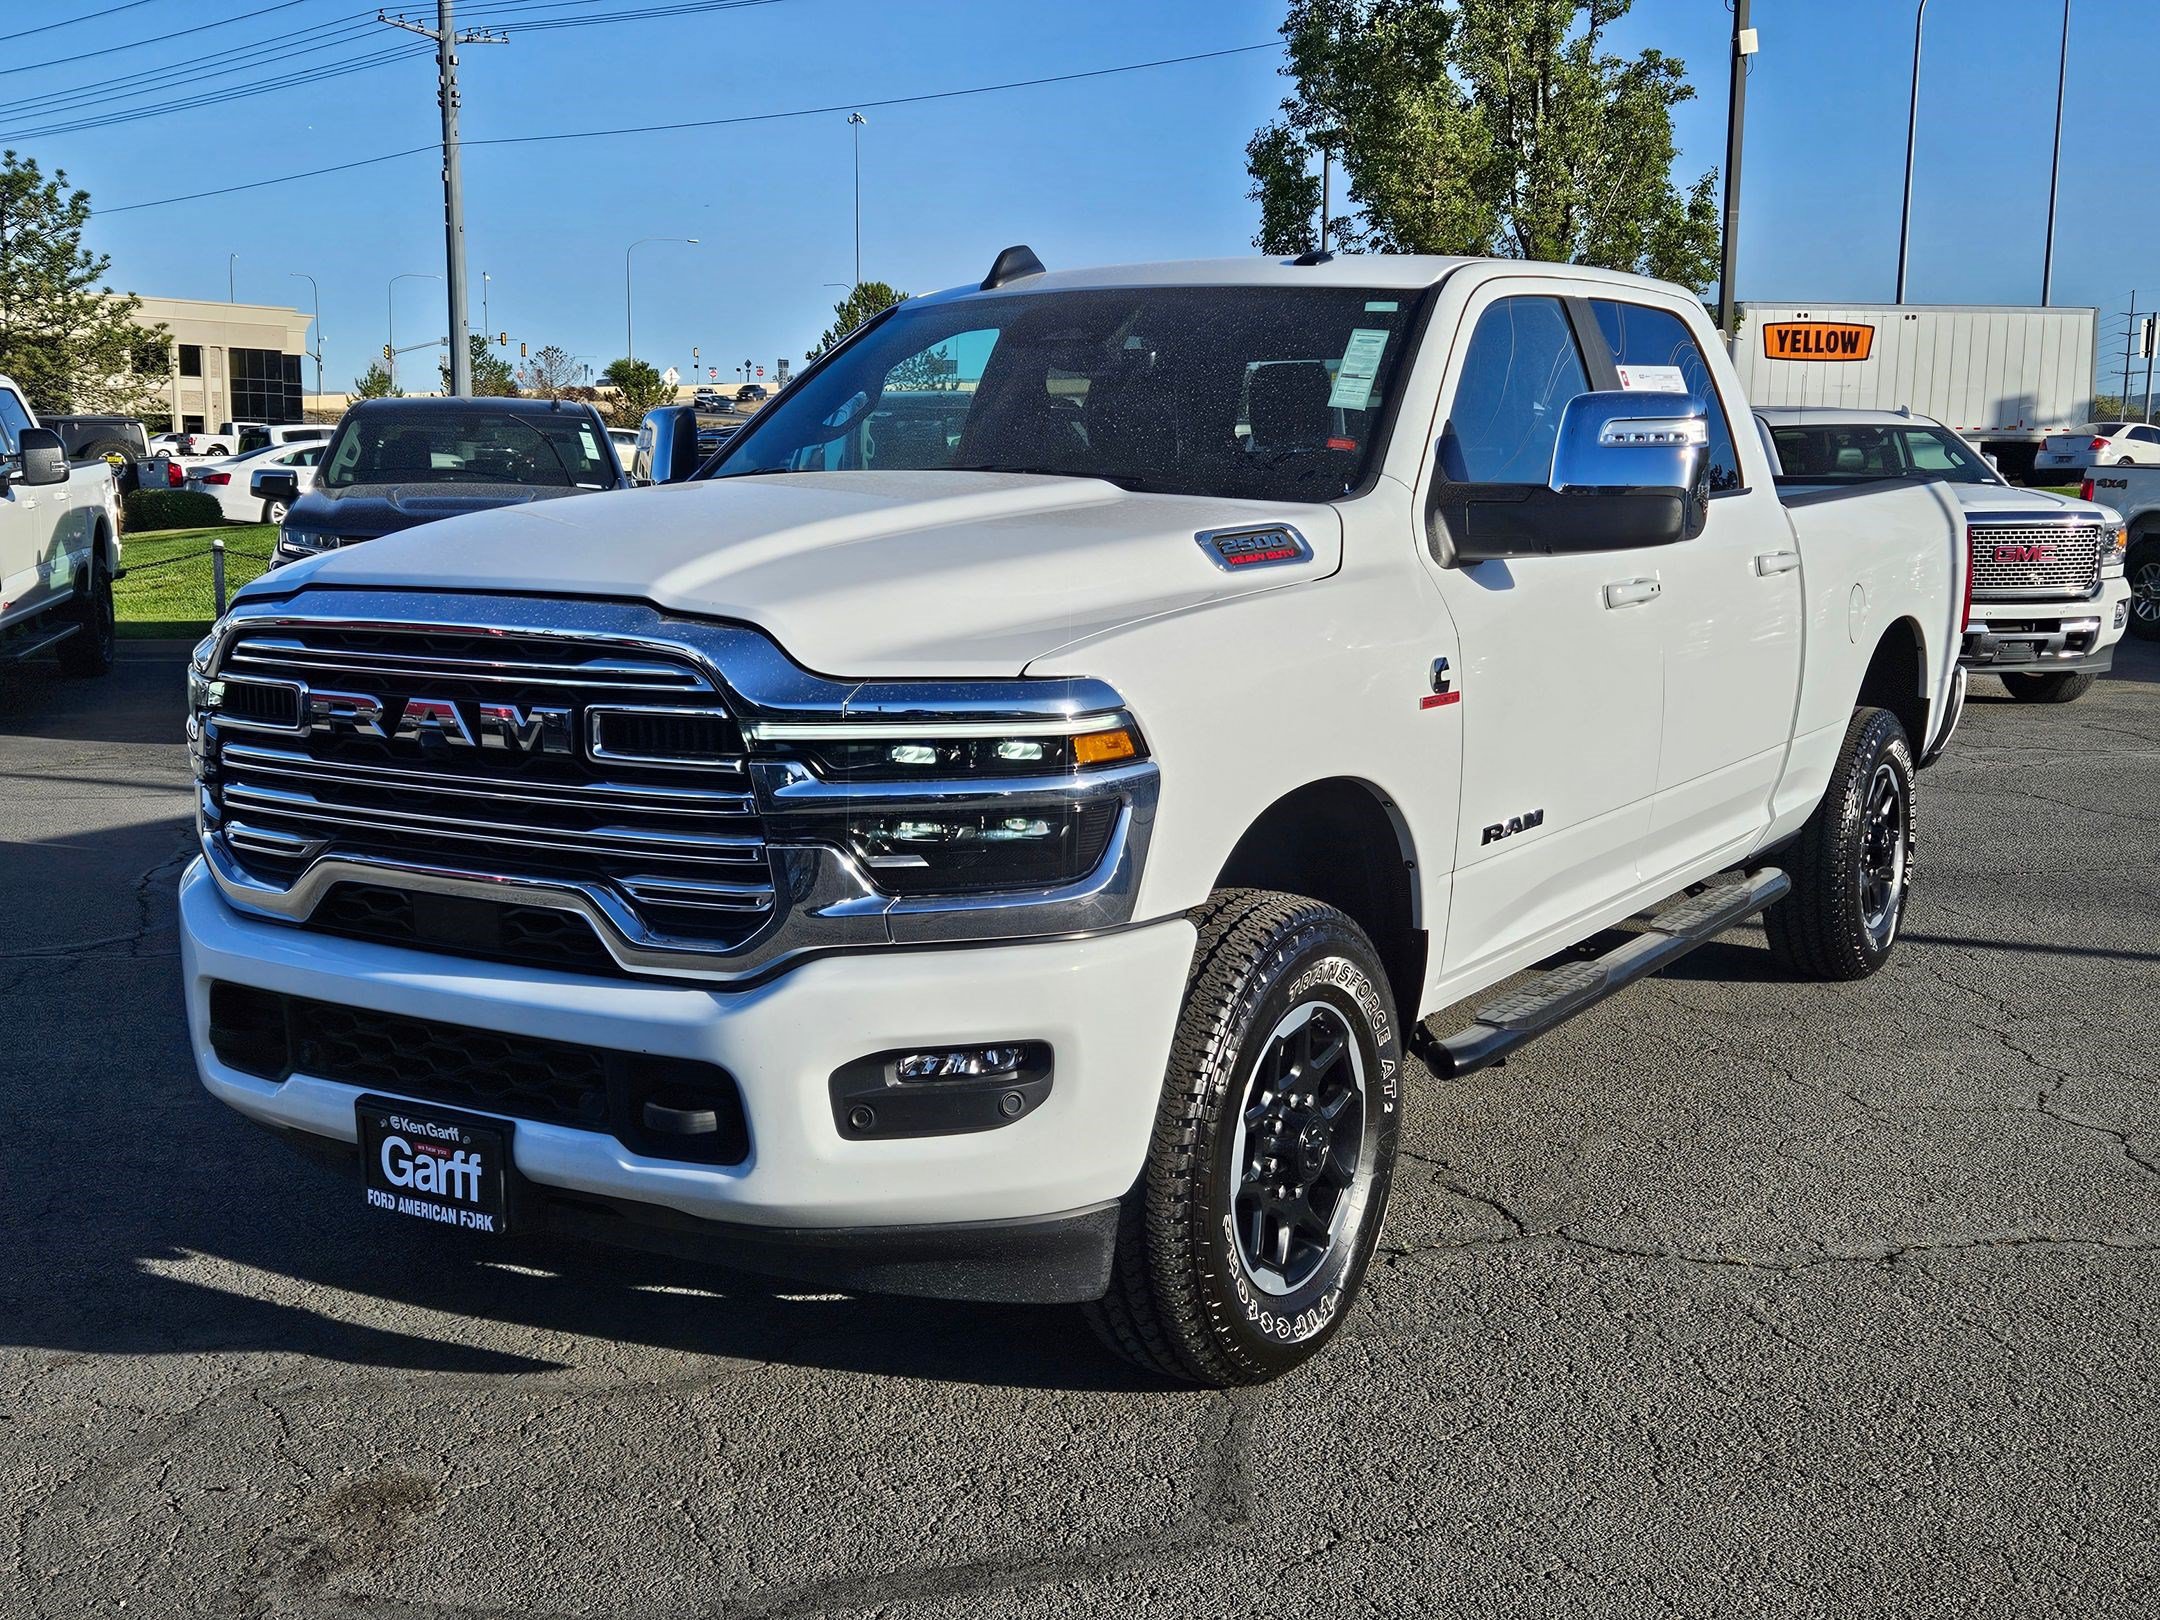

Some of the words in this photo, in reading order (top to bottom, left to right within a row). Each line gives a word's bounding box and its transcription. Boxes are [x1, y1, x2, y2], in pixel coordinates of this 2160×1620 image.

[1777, 329, 1860, 353] YELLOW
[1219, 534, 1287, 553] 2500
[1230, 553, 1265, 564] HEAVY
[1265, 549, 1295, 560] DUTY
[1994, 545, 2058, 562] GMC
[309, 689, 573, 755] RAM
[1480, 808, 1544, 847] RAM
[1288, 961, 1392, 1048] TRANSFORCE
[381, 1135, 482, 1203] Garff
[367, 1188, 396, 1210] FORD
[398, 1197, 457, 1225] AMERICAN
[460, 1210, 494, 1232] FORK
